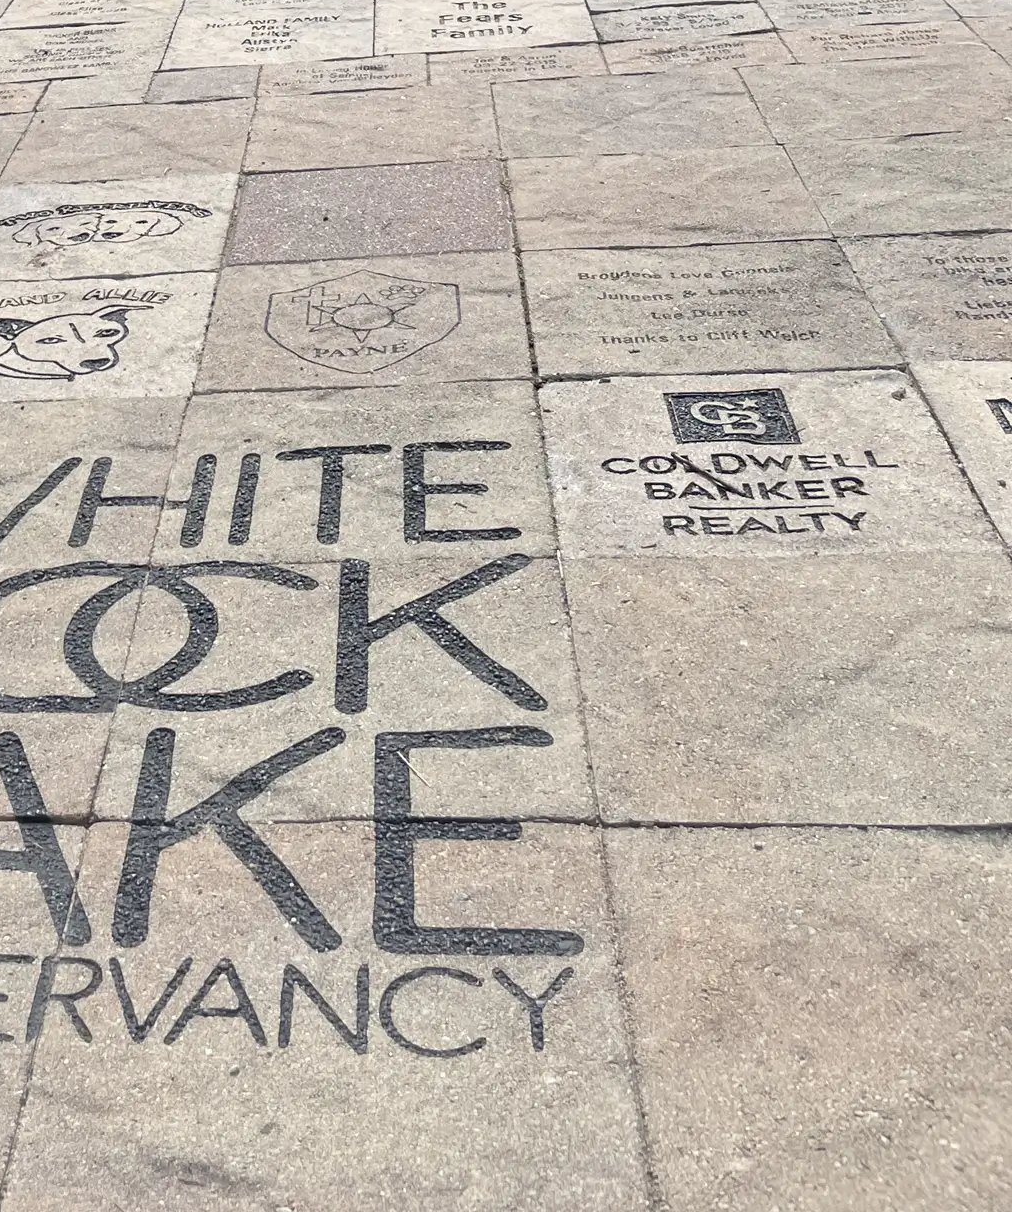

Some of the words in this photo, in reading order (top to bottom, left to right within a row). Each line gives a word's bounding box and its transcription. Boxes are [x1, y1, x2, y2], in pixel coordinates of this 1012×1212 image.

[451, 1, 508, 11] The
[284, 15, 341, 25] FAMILY
[438, 13, 524, 25] Fears
[430, 25, 534, 39] Family
[55, 200, 213, 219] RETRIEVERS
[922, 256, 946, 265] To
[671, 271, 714, 279] Love
[81, 287, 175, 305] ALLIE
[682, 290, 697, 299] &
[599, 334, 670, 345] Thanks
[678, 334, 699, 342] to
[313, 342, 410, 359] PAYNE
[600, 450, 900, 476] COLDWELL
[644, 476, 871, 501] BANKER
[662, 511, 867, 537] REALTY
